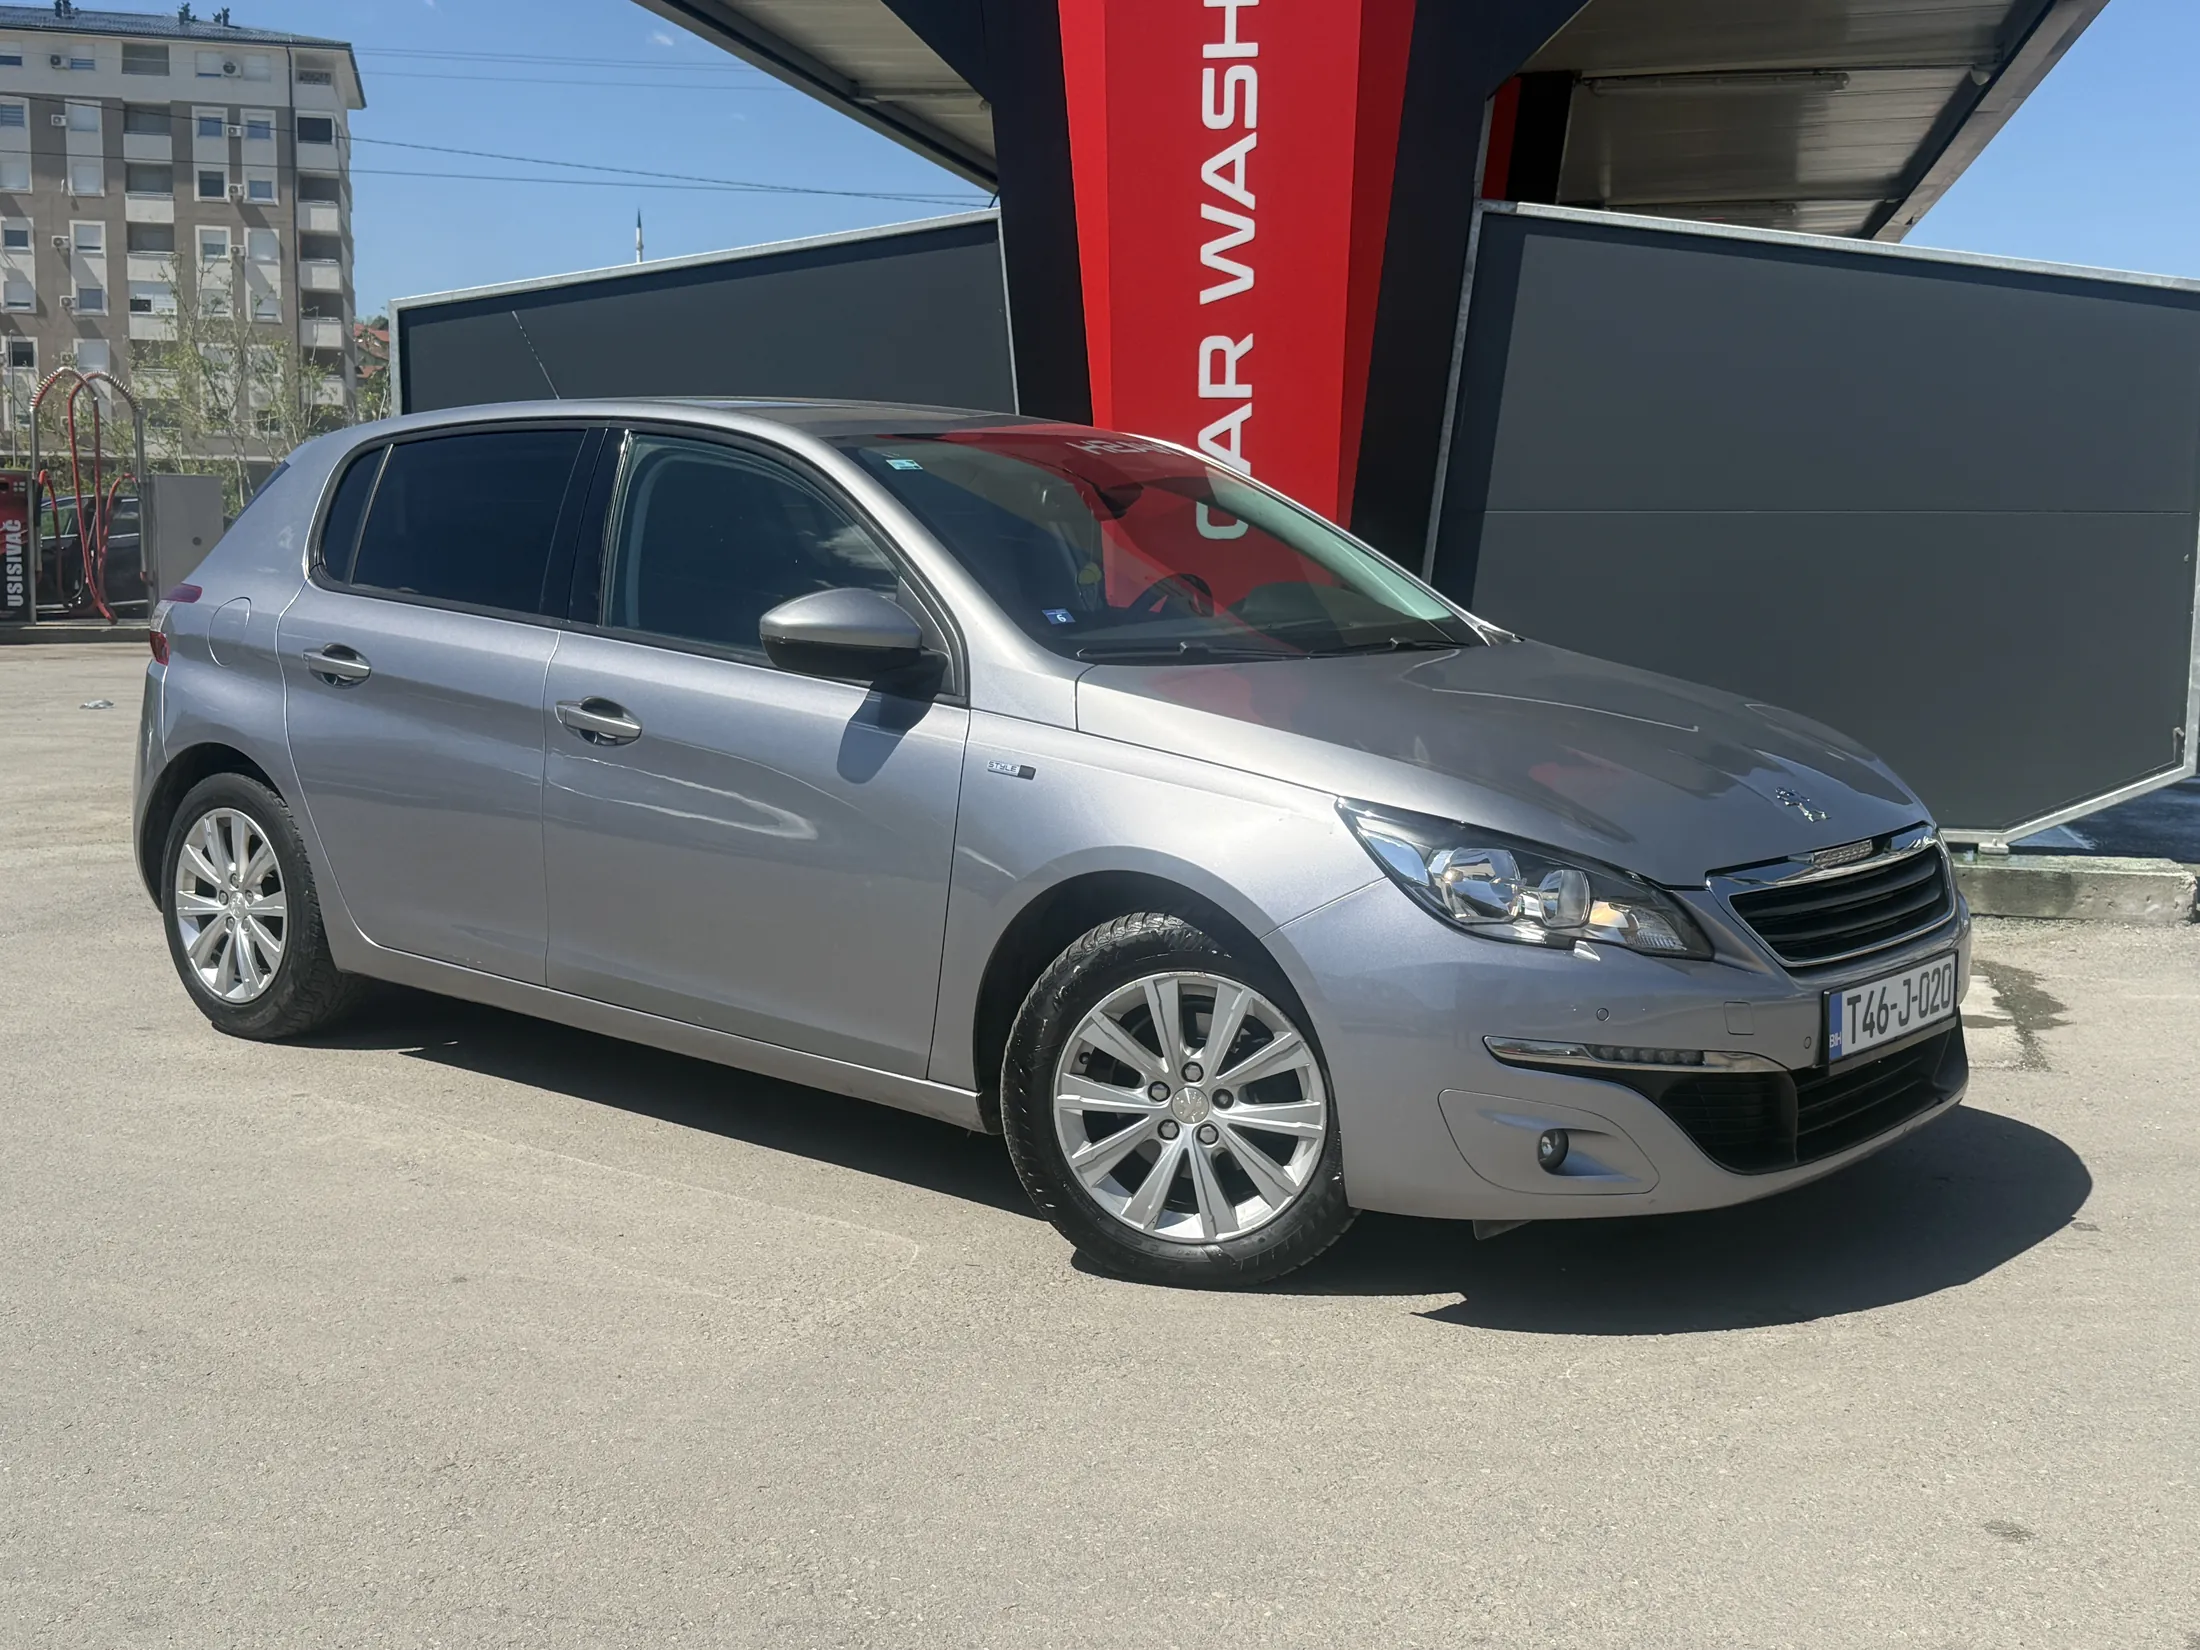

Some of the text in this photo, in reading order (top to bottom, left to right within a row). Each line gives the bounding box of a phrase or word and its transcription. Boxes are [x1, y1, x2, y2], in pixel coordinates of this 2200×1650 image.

[1200, 0, 1259, 305] WASH
[987, 760, 1019, 773] STYLE
[1846, 963, 1952, 1044] T46-J-020
[1829, 1031, 1842, 1048] BIH
